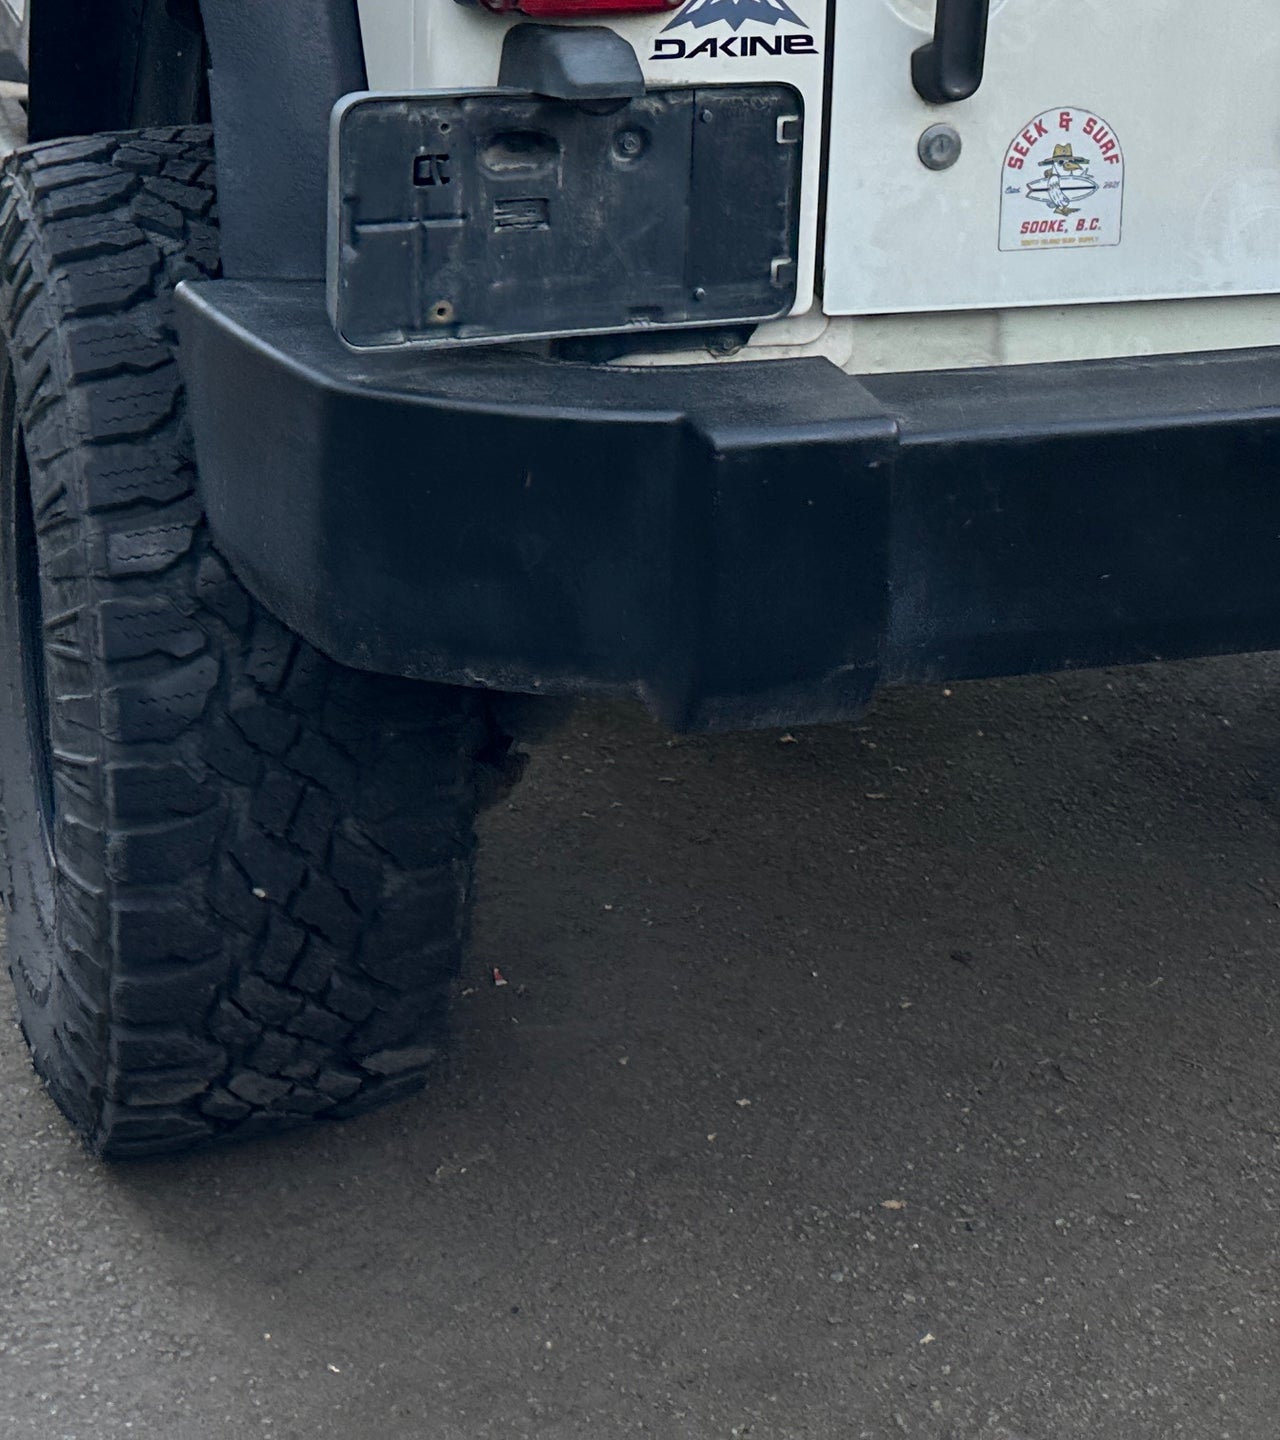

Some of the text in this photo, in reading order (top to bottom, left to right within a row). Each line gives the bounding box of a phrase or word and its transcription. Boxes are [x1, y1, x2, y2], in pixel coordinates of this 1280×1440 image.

[648, 34, 820, 60] DAKINE
[1007, 112, 1120, 170] SEEK & SURF
[1020, 218, 1102, 234] SOOKE, B.C.
